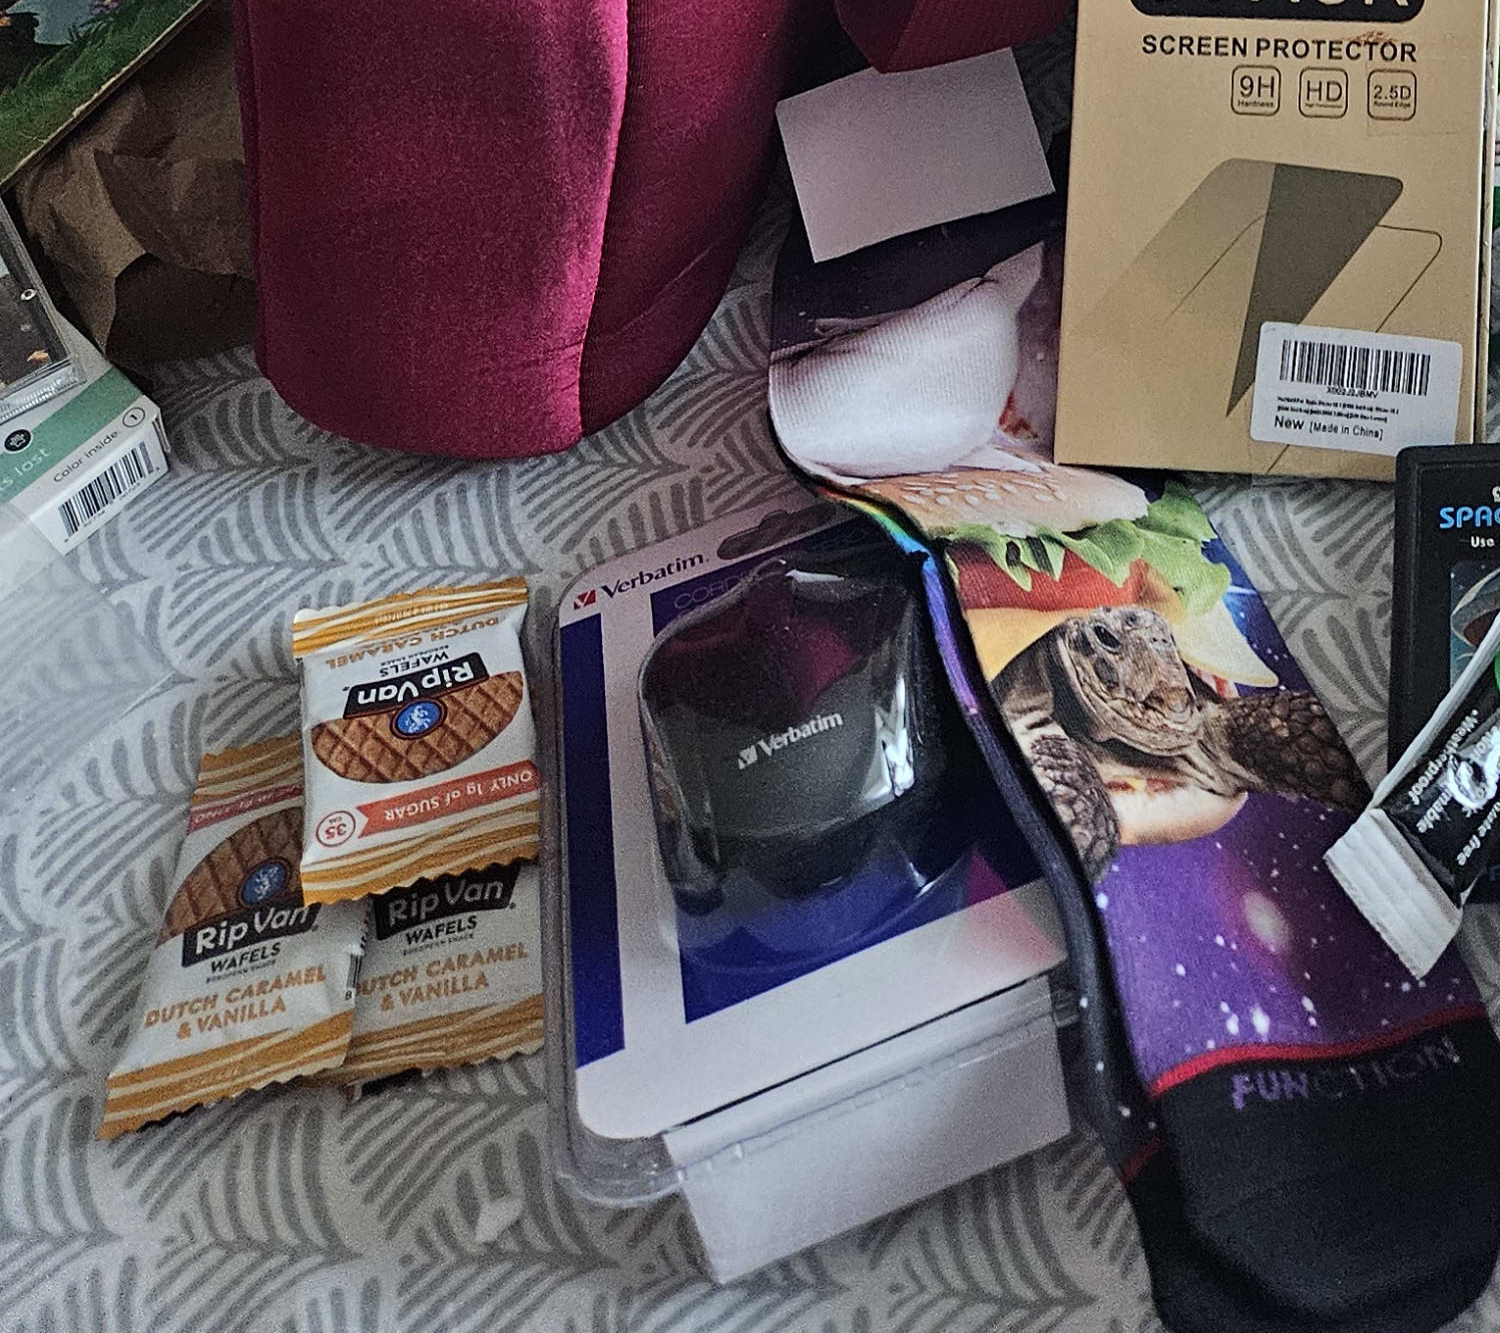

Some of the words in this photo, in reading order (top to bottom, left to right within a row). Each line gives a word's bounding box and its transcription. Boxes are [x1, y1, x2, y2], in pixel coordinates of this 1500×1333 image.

[1142, 34, 1248, 58] SCREEN
[1256, 37, 1417, 63] PROTECTOR
[1240, 75, 1275, 98] 9H
[1306, 80, 1343, 103] HD
[1373, 84, 1411, 101] 2.5D
[1274, 416, 1305, 430] New
[15, 448, 49, 476] lost
[53, 459, 83, 483] Color
[86, 431, 120, 459] inside
[1470, 535, 1496, 549] Use
[602, 550, 703, 599] Verbatim
[431, 616, 499, 643] DUTCH
[324, 634, 423, 670] CARAMEL
[379, 650, 449, 678] WAFELS
[421, 661, 474, 690] Rip
[357, 682, 420, 705] Van
[759, 710, 845, 754] Verbatim
[1402, 711, 1481, 807] Weatherproof
[489, 770, 533, 792] ONLY
[384, 799, 440, 821] SUGAR
[445, 789, 461, 803] of
[324, 822, 347, 840] 35
[1454, 834, 1484, 868] free
[387, 890, 440, 928] Rip
[446, 877, 504, 911] Van
[194, 918, 248, 956] Rip
[255, 901, 311, 933] Van
[405, 915, 477, 946] WAFELS
[210, 942, 281, 974] WAFELS
[425, 941, 529, 980] CARAMEL
[145, 992, 217, 1029] DUTCH
[224, 964, 327, 1008] CARAMEL
[379, 993, 396, 1012] &
[400, 972, 490, 1007] VANILLA
[176, 1021, 193, 1040] &
[198, 996, 287, 1031] VANILLA
